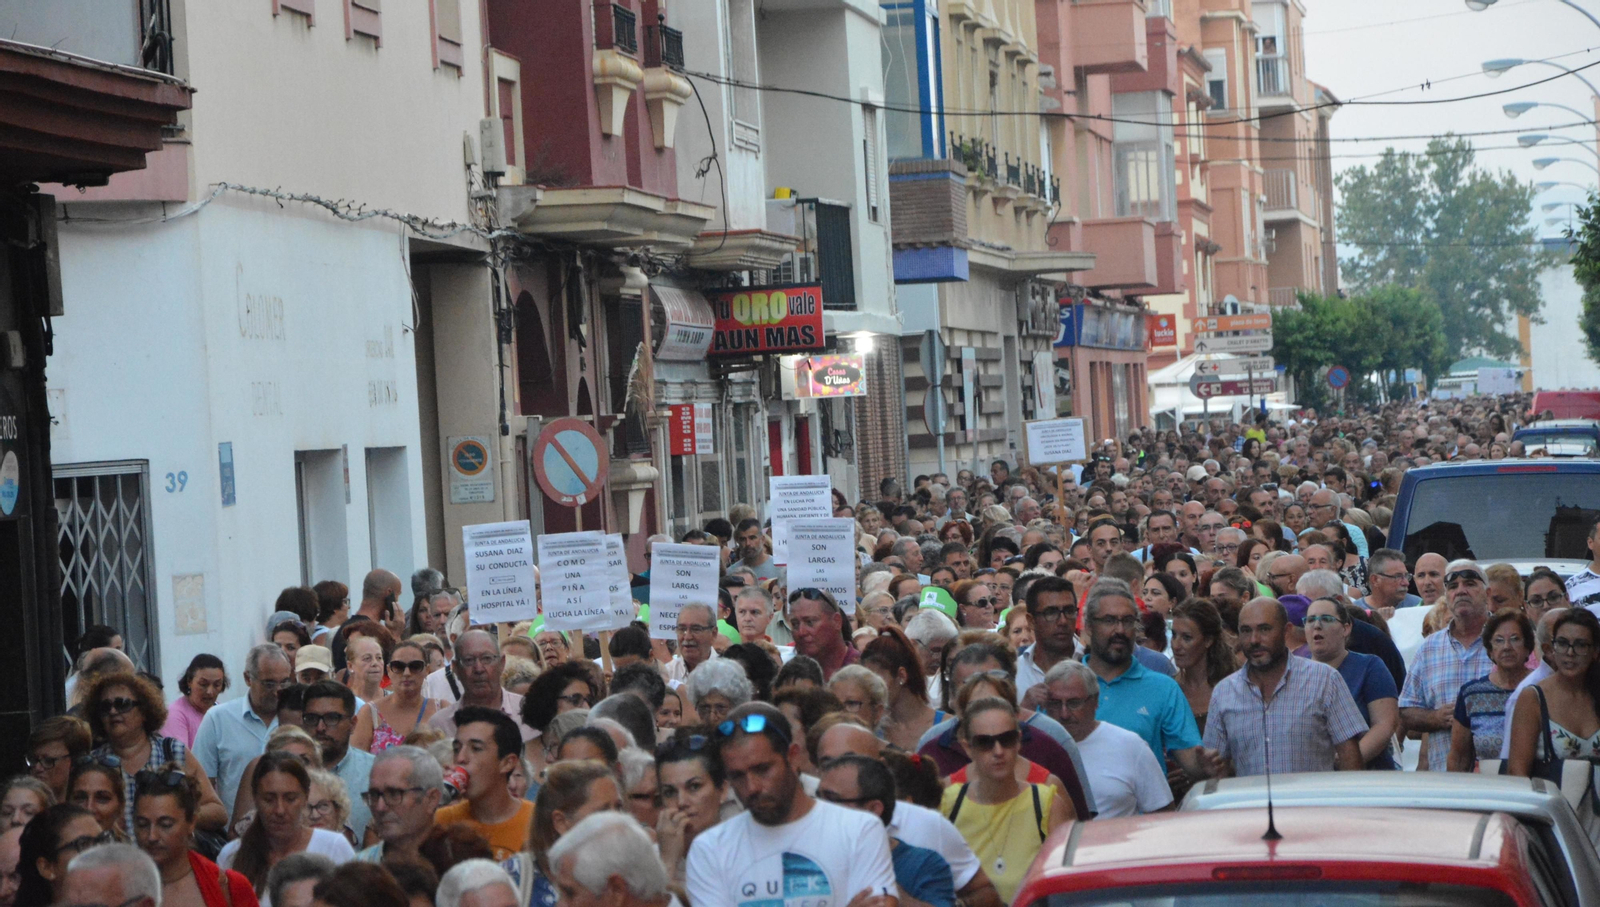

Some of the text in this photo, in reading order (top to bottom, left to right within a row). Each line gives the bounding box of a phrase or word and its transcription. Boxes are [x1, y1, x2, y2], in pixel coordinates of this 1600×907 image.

[733, 291, 787, 326] ORO
[788, 291, 816, 316] vale
[714, 328, 760, 351] AUN
[765, 325, 816, 348] MAS
[681, 406, 692, 452] COMPRO ORO
[165, 470, 188, 494] 39
[497, 537, 526, 545] ANDALUCIA
[475, 547, 524, 558] SUSANA DIAZ
[571, 547, 600, 555] ANDALUCIA
[488, 559, 528, 570] CONDUCTA
[557, 558, 586, 567] COMO
[808, 556, 836, 564] LARGAS
[564, 571, 581, 579] UNA
[676, 569, 691, 577] SON
[561, 583, 586, 592] PIÑA
[671, 582, 699, 590] LARGAS
[481, 585, 523, 597] EN LA LÍNEA
[566, 596, 582, 604] ASÍ
[480, 600, 514, 610] HOSPITAL
[548, 610, 573, 619] LUCHA
[584, 607, 605, 616] LÍNEA
